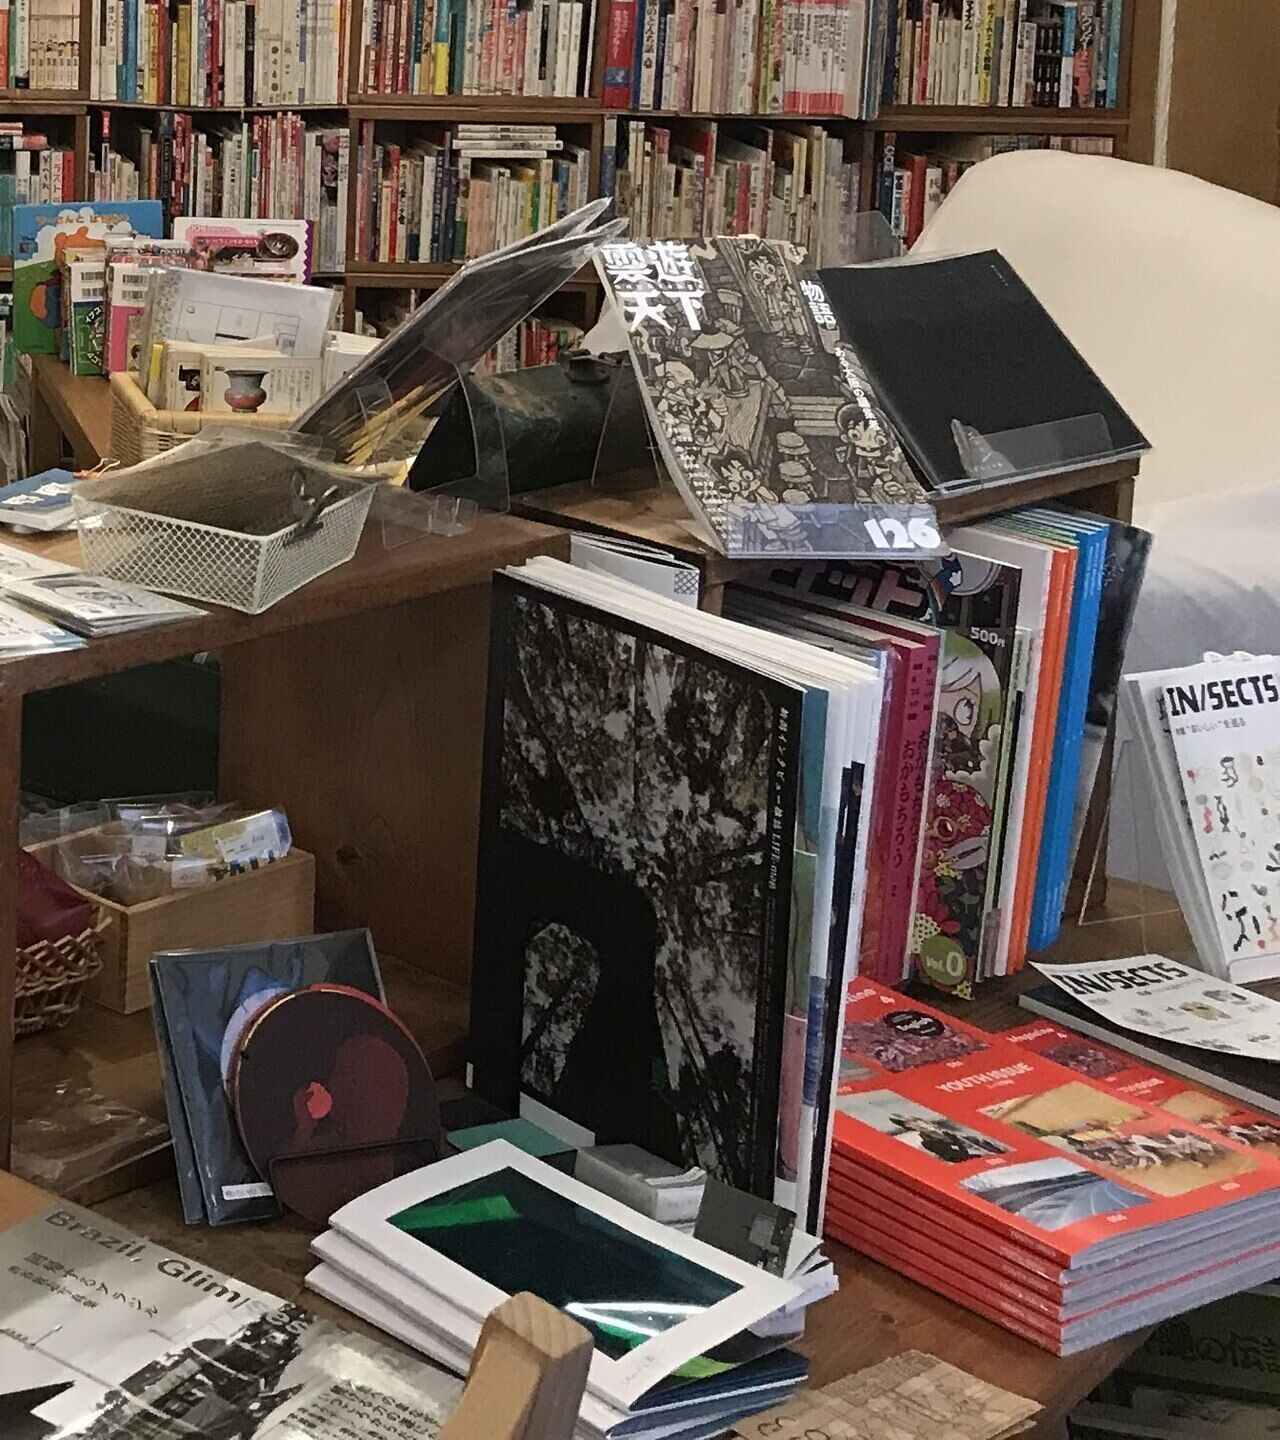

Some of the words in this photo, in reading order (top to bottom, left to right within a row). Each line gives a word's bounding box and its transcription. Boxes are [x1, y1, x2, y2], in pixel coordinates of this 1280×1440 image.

[621, 290, 706, 333] 天下
[800, 279, 837, 327] 物語
[863, 517, 941, 550] 126
[1165, 673, 1279, 717] IN/SECTS
[1055, 961, 1190, 996] IN/SECTS
[935, 1071, 990, 1094] YOUTH
[44, 1209, 146, 1263] Brazil,
